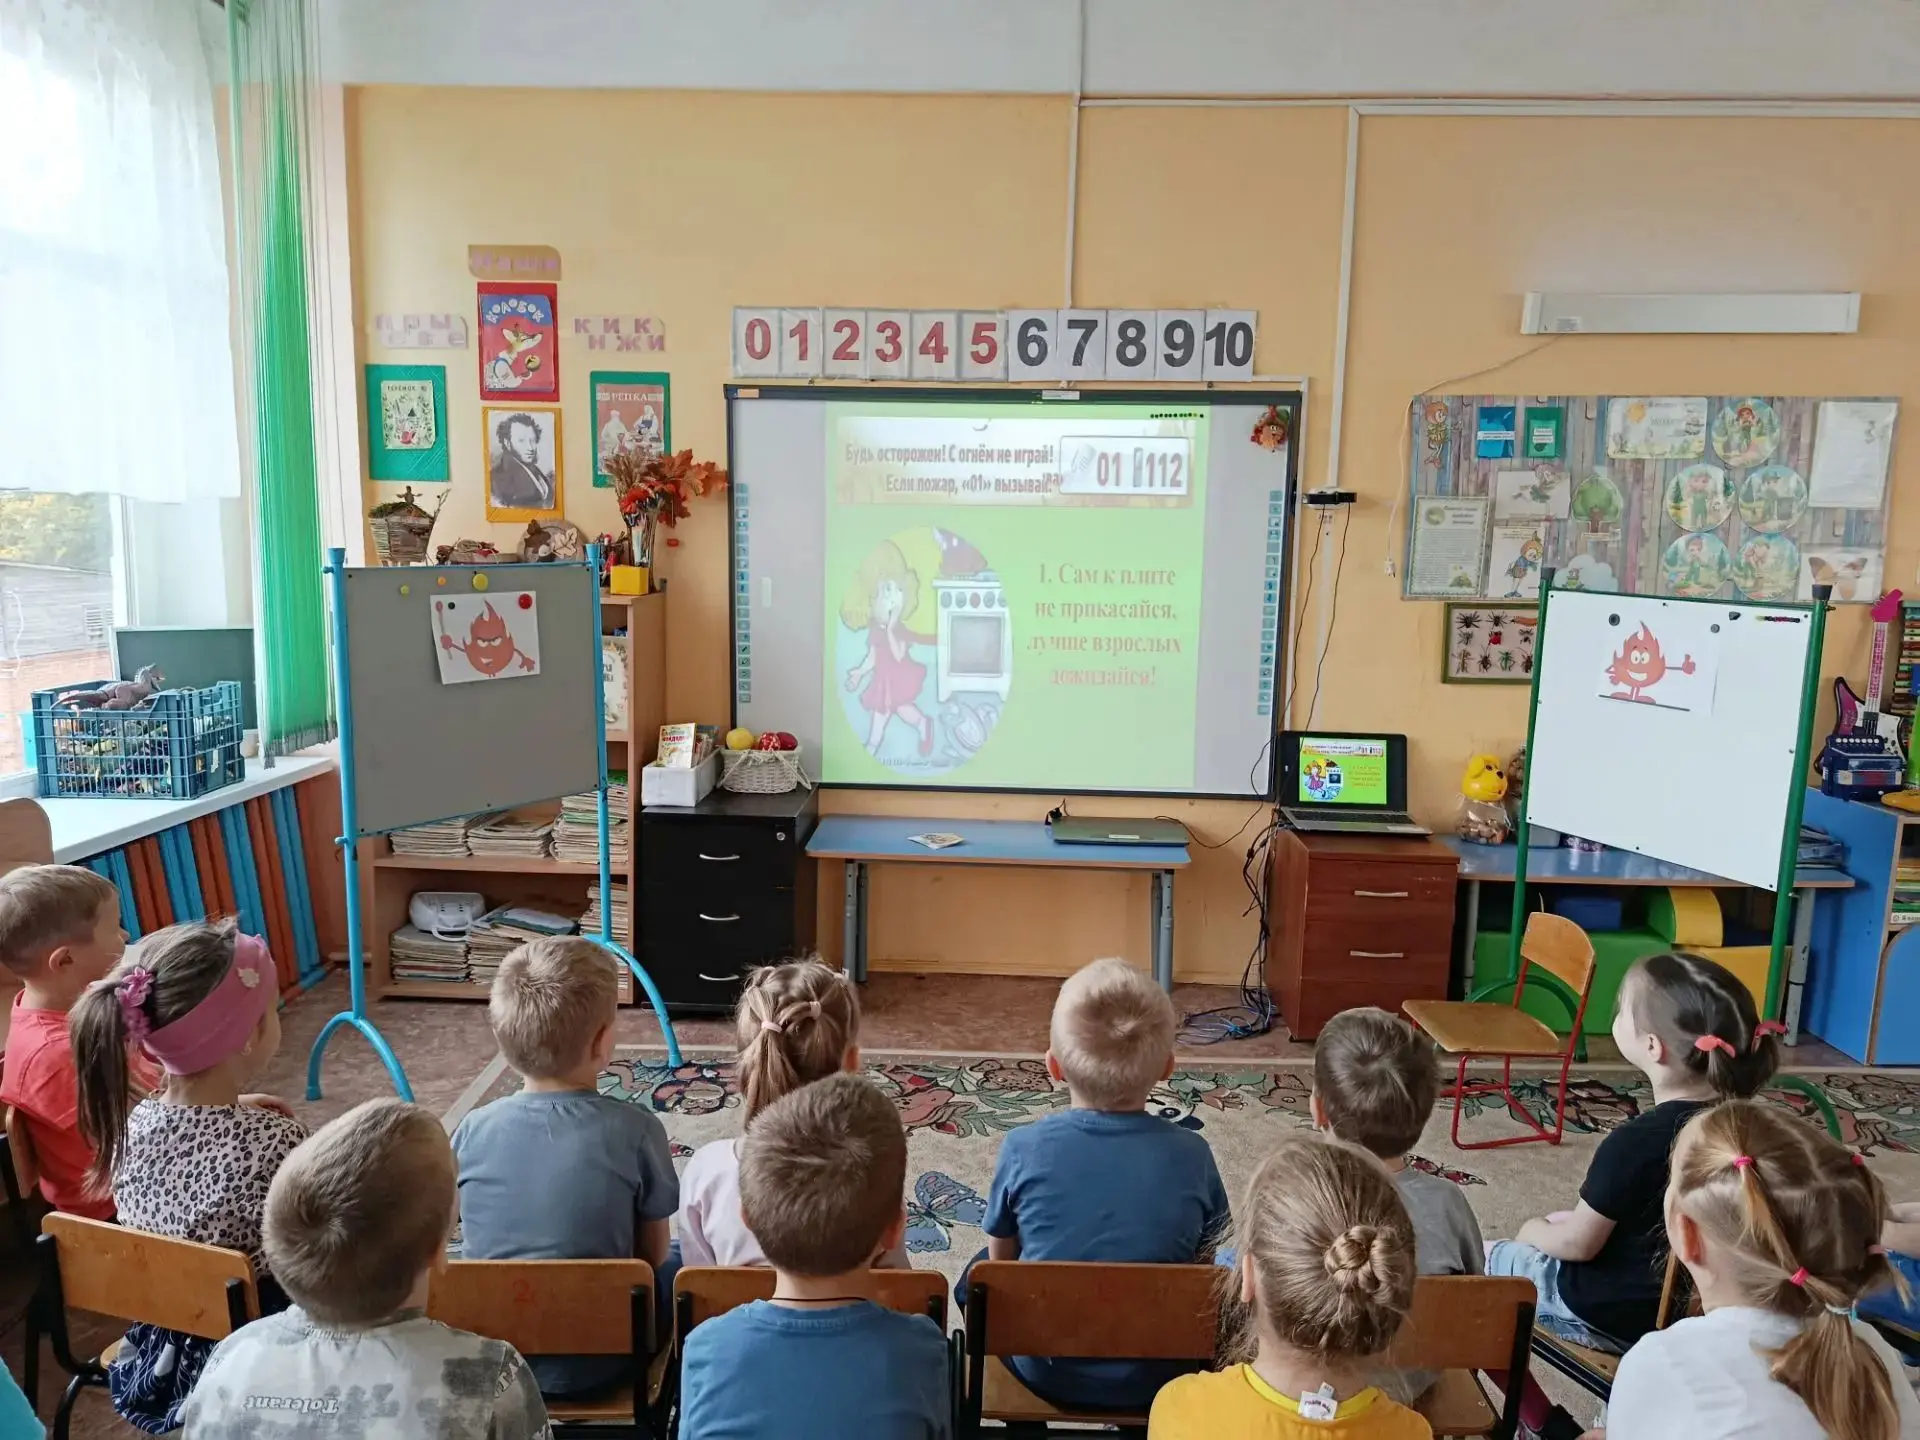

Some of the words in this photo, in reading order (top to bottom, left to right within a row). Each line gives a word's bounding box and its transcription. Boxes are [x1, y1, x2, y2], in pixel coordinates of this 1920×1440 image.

[745, 318, 772, 360] 0
[789, 319, 809, 361] 1
[832, 319, 860, 361] 2
[875, 320, 903, 363] 3
[919, 321, 949, 364] 4
[970, 322, 998, 365] 5
[1017, 318, 1049, 367] 6
[1067, 319, 1098, 367] 7
[1115, 319, 1147, 367] 8
[1163, 319, 1195, 368] 9
[1205, 321, 1254, 367] 10
[845, 444, 874, 466] Будь
[877, 444, 946, 467] осторожен!
[959, 444, 995, 464] огнём
[997, 449, 1012, 464] не
[1014, 444, 1054, 468] играй!
[1096, 452, 1122, 487] 01
[1146, 452, 1183, 488] 112
[886, 474, 914, 492] Если
[917, 476, 958, 497] пожар,
[1040, 563, 1052, 584] 1.
[1058, 563, 1098, 585] Сам
[1103, 569, 1116, 585] к
[1120, 569, 1176, 586] плите
[1035, 602, 1056, 618] не
[1027, 635, 1088, 656] лучше
[1092, 635, 1182, 657] взрослых
[245, 1394, 339, 1415] Tolerant
